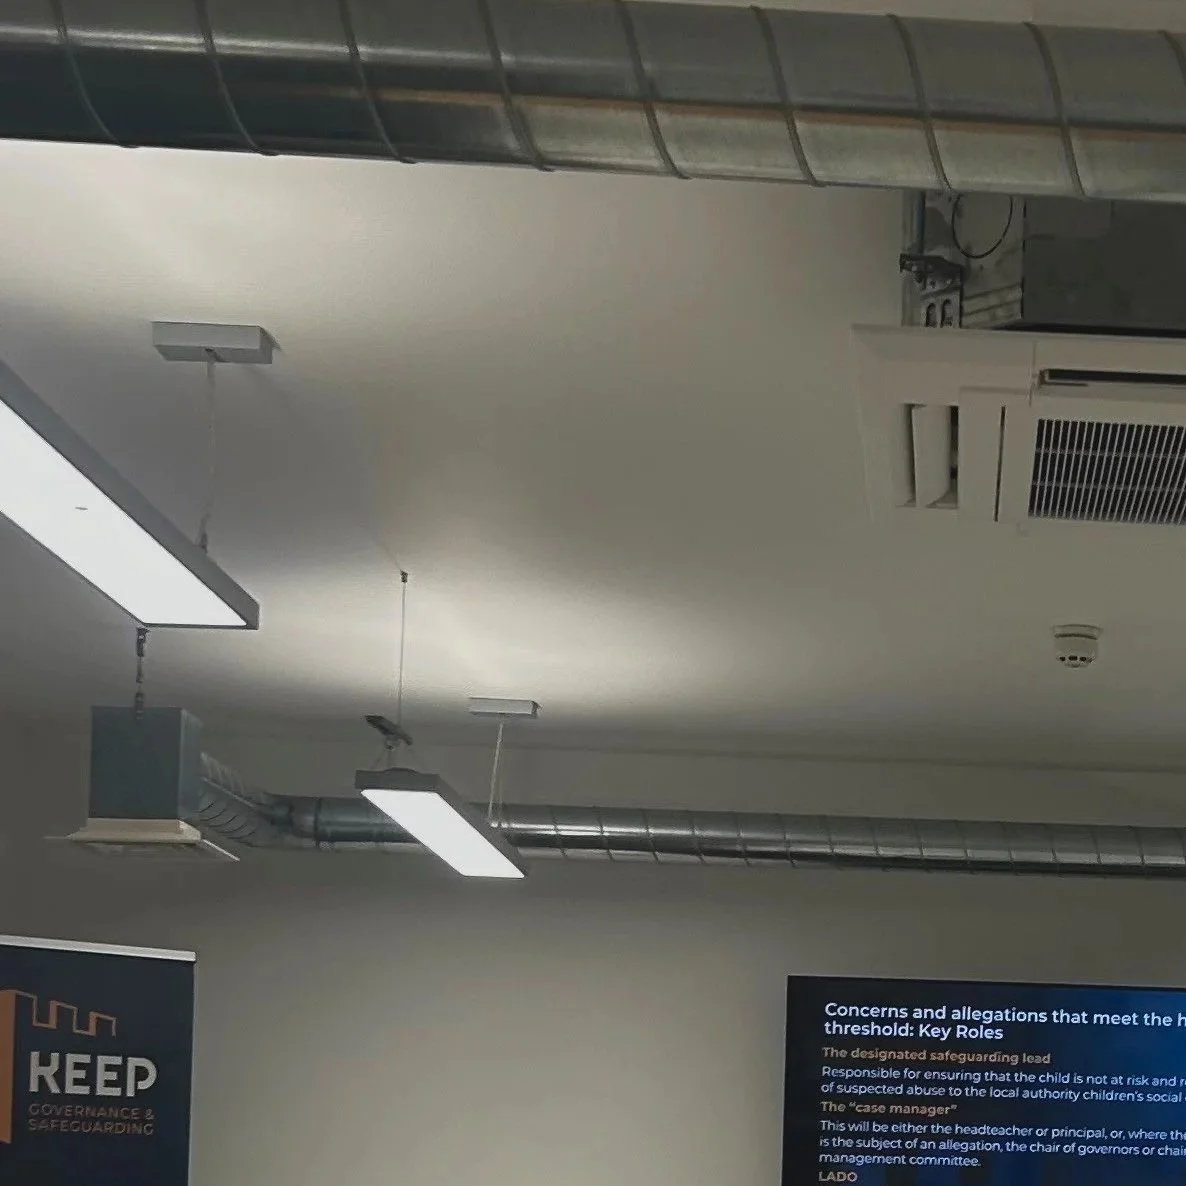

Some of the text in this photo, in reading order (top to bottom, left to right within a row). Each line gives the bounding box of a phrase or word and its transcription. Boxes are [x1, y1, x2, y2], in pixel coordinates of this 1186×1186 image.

[824, 1002, 908, 1018] Concerns
[912, 1005, 946, 1020] and
[951, 1005, 1048, 1024] allegations
[1051, 1008, 1088, 1024] that
[1093, 1012, 1139, 1025] meet
[1143, 1012, 1173, 1027] the
[824, 1020, 1003, 1041] threshold: Key Roles
[821, 1046, 1051, 1066] The designated safeguarding lead
[29, 1051, 157, 1097] KEEP
[821, 1065, 901, 1079] Responsible
[903, 1067, 922, 1080] for
[923, 1069, 982, 1084] ensuring
[983, 1070, 1011, 1082] that
[1013, 1071, 1036, 1083] the
[1038, 1071, 1070, 1084] child
[1072, 1072, 1084, 1084] is
[1085, 1074, 1108, 1085] not
[1110, 1075, 1124, 1085] at
[1126, 1074, 1149, 1086] risk
[1151, 1075, 1177, 1087] and
[820, 1081, 835, 1093] of
[836, 1083, 904, 1095] suspected
[905, 1084, 946, 1096] abuse
[948, 1086, 963, 1097] to
[963, 1085, 987, 1097] the
[989, 1086, 1019, 1098] local
[1021, 1087, 1081, 1102] authority
[1145, 1091, 1182, 1103] social
[29, 1103, 155, 1121] GOVERNANCE &
[819, 1100, 846, 1112] The
[29, 1118, 155, 1136] SAFEGUARDING
[819, 1119, 846, 1132] This
[847, 1120, 870, 1132] will
[872, 1120, 889, 1132] be
[890, 1121, 929, 1134] either
[930, 1122, 952, 1134] the
[954, 1123, 1034, 1137] headteacher
[1035, 1127, 1049, 1137] or
[1127, 1128, 1168, 1140] where
[819, 1133, 830, 1147] is
[831, 1135, 854, 1148] the
[855, 1136, 903, 1151] subject
[904, 1137, 919, 1149] of
[919, 1140, 936, 1150] an
[1004, 1140, 1028, 1152] the
[1029, 1140, 1061, 1153] chair
[1062, 1141, 1076, 1153] of
[1077, 1144, 1140, 1156] governors
[1141, 1146, 1156, 1156] or
[818, 1153, 906, 1166] management
[818, 1171, 858, 1182] LADO
